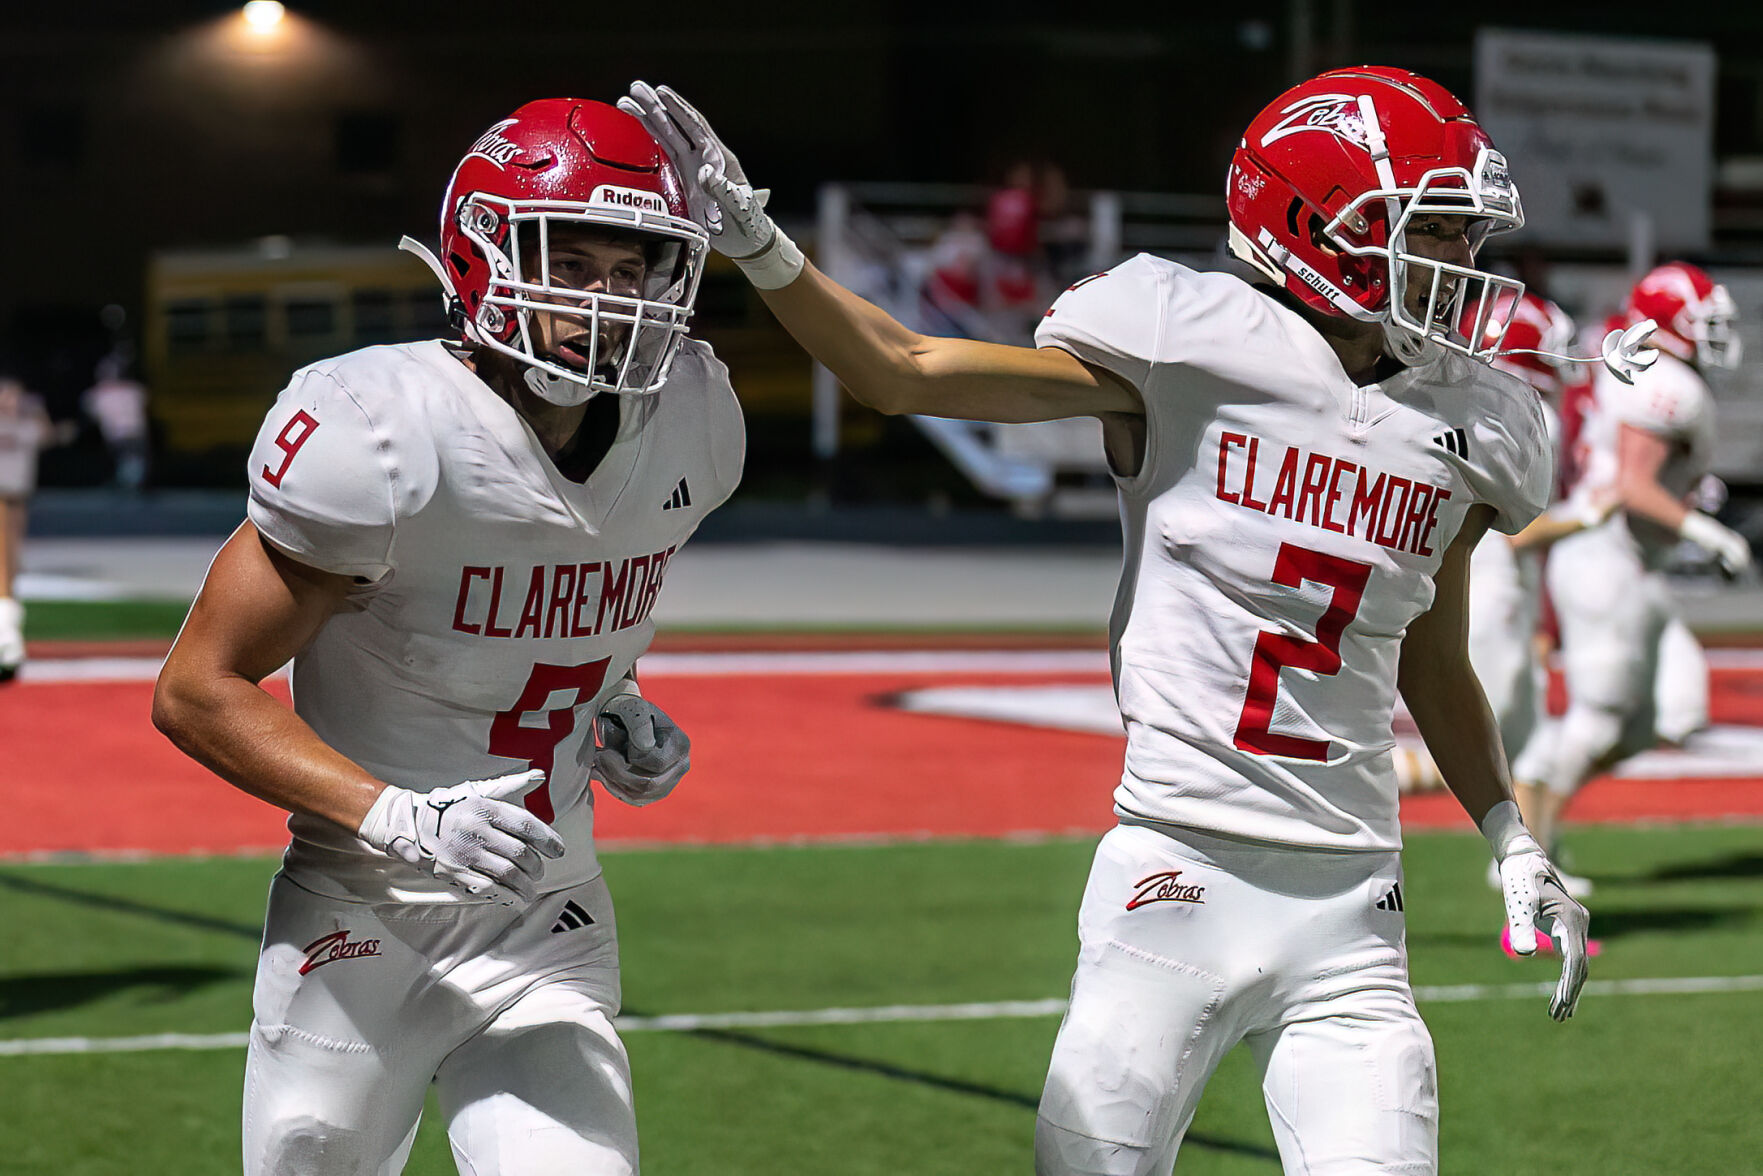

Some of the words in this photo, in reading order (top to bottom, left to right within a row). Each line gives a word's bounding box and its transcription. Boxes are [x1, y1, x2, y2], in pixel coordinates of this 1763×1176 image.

[262, 408, 320, 490] 9
[1216, 431, 1452, 557] CLAREMORE
[1233, 541, 1373, 763] 2
[488, 654, 613, 825] 9
[1126, 870, 1206, 912] Zebras
[298, 929, 382, 977] Zebras
